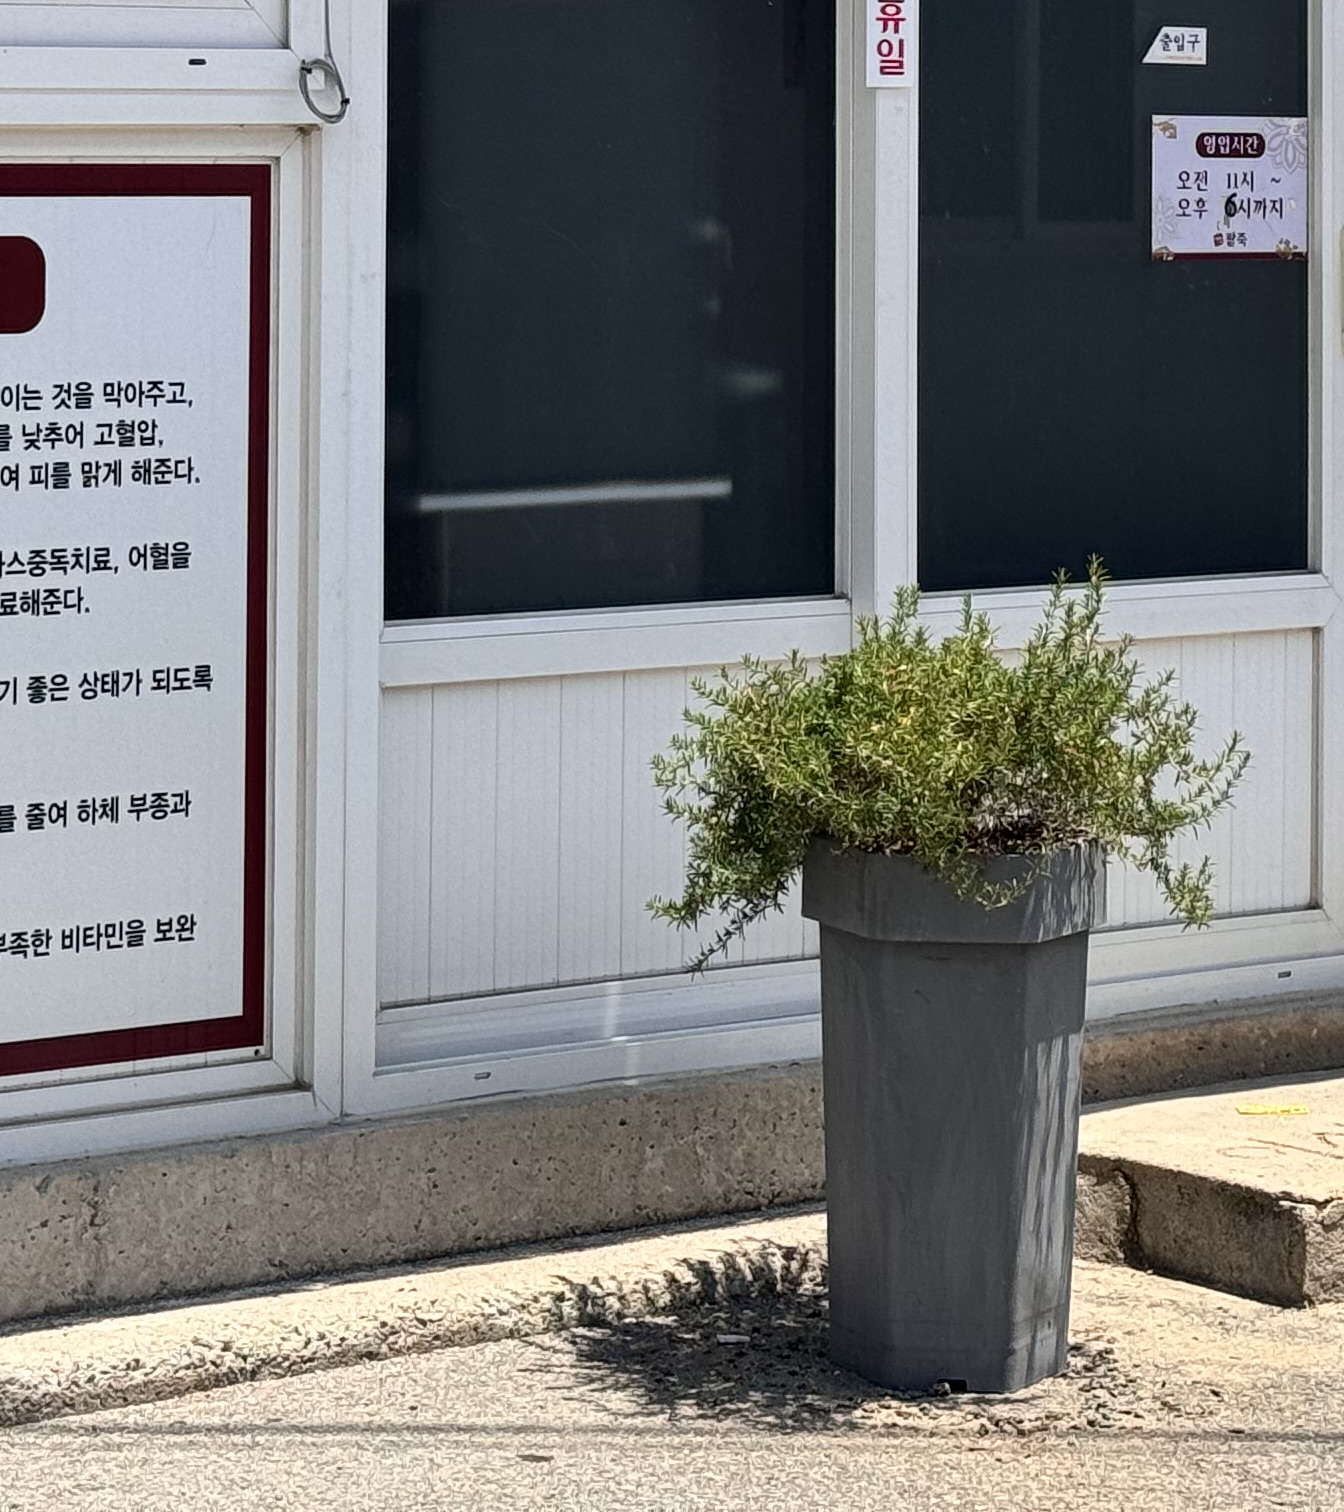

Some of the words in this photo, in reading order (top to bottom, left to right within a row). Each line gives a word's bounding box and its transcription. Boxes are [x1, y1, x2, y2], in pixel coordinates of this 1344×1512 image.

[1159, 32, 1201, 53] 출입구
[1203, 139, 1260, 155] 영업시간
[1176, 170, 1208, 190] 오전
[1175, 197, 1208, 219] 오후
[51, 381, 95, 411] 것을
[102, 379, 193, 409] 막아주고,
[21, 420, 84, 452] 낮추어
[93, 418, 164, 448] 고혈압,
[28, 461, 73, 491] 피를
[80, 458, 122, 489] 맑게
[130, 456, 201, 486] 해준다.
[128, 541, 192, 572] 어혈을
[25, 673, 71, 705] 좋은
[77, 668, 143, 701] 상태가
[149, 663, 215, 696] 되도록
[24, 799, 68, 831] 줄여
[76, 795, 120, 826] 하체
[126, 789, 193, 823] 부종과
[60, 918, 147, 954] 비타민을
[153, 913, 198, 943] 보완
